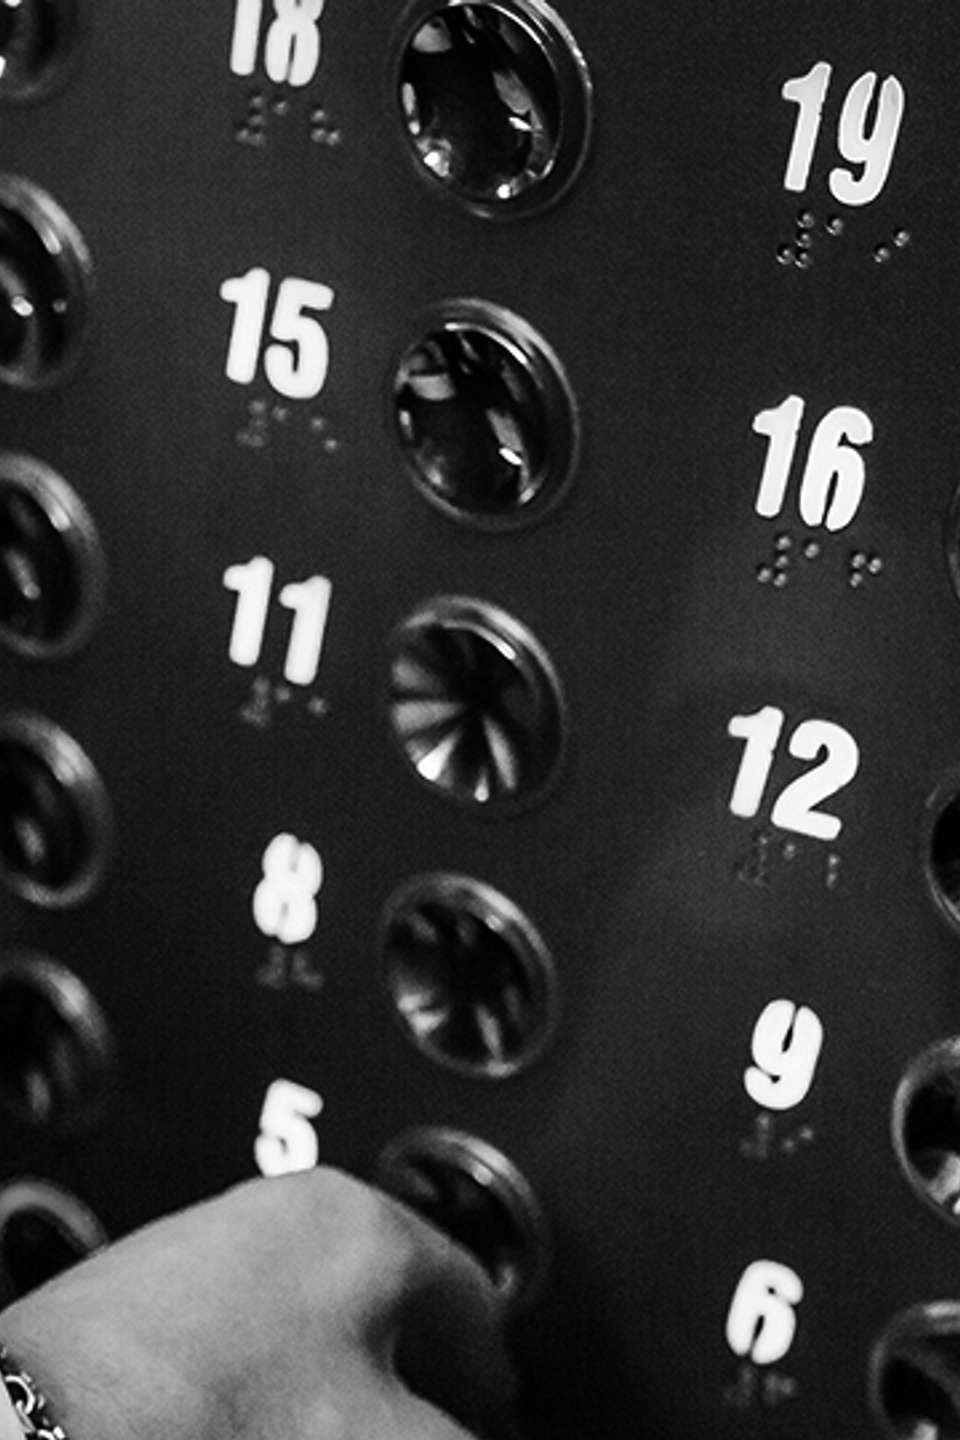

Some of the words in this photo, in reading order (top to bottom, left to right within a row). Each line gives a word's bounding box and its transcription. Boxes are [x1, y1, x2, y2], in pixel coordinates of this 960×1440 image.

[228, 0, 326, 88] 18
[780, 59, 906, 208] 19
[218, 266, 336, 401] 15
[750, 392, 875, 534] 16
[221, 555, 333, 687] 11
[726, 704, 861, 842] 12
[251, 832, 324, 945] 8
[742, 997, 825, 1112] 9
[254, 1078, 323, 1176] 5
[725, 1259, 805, 1366] 6
